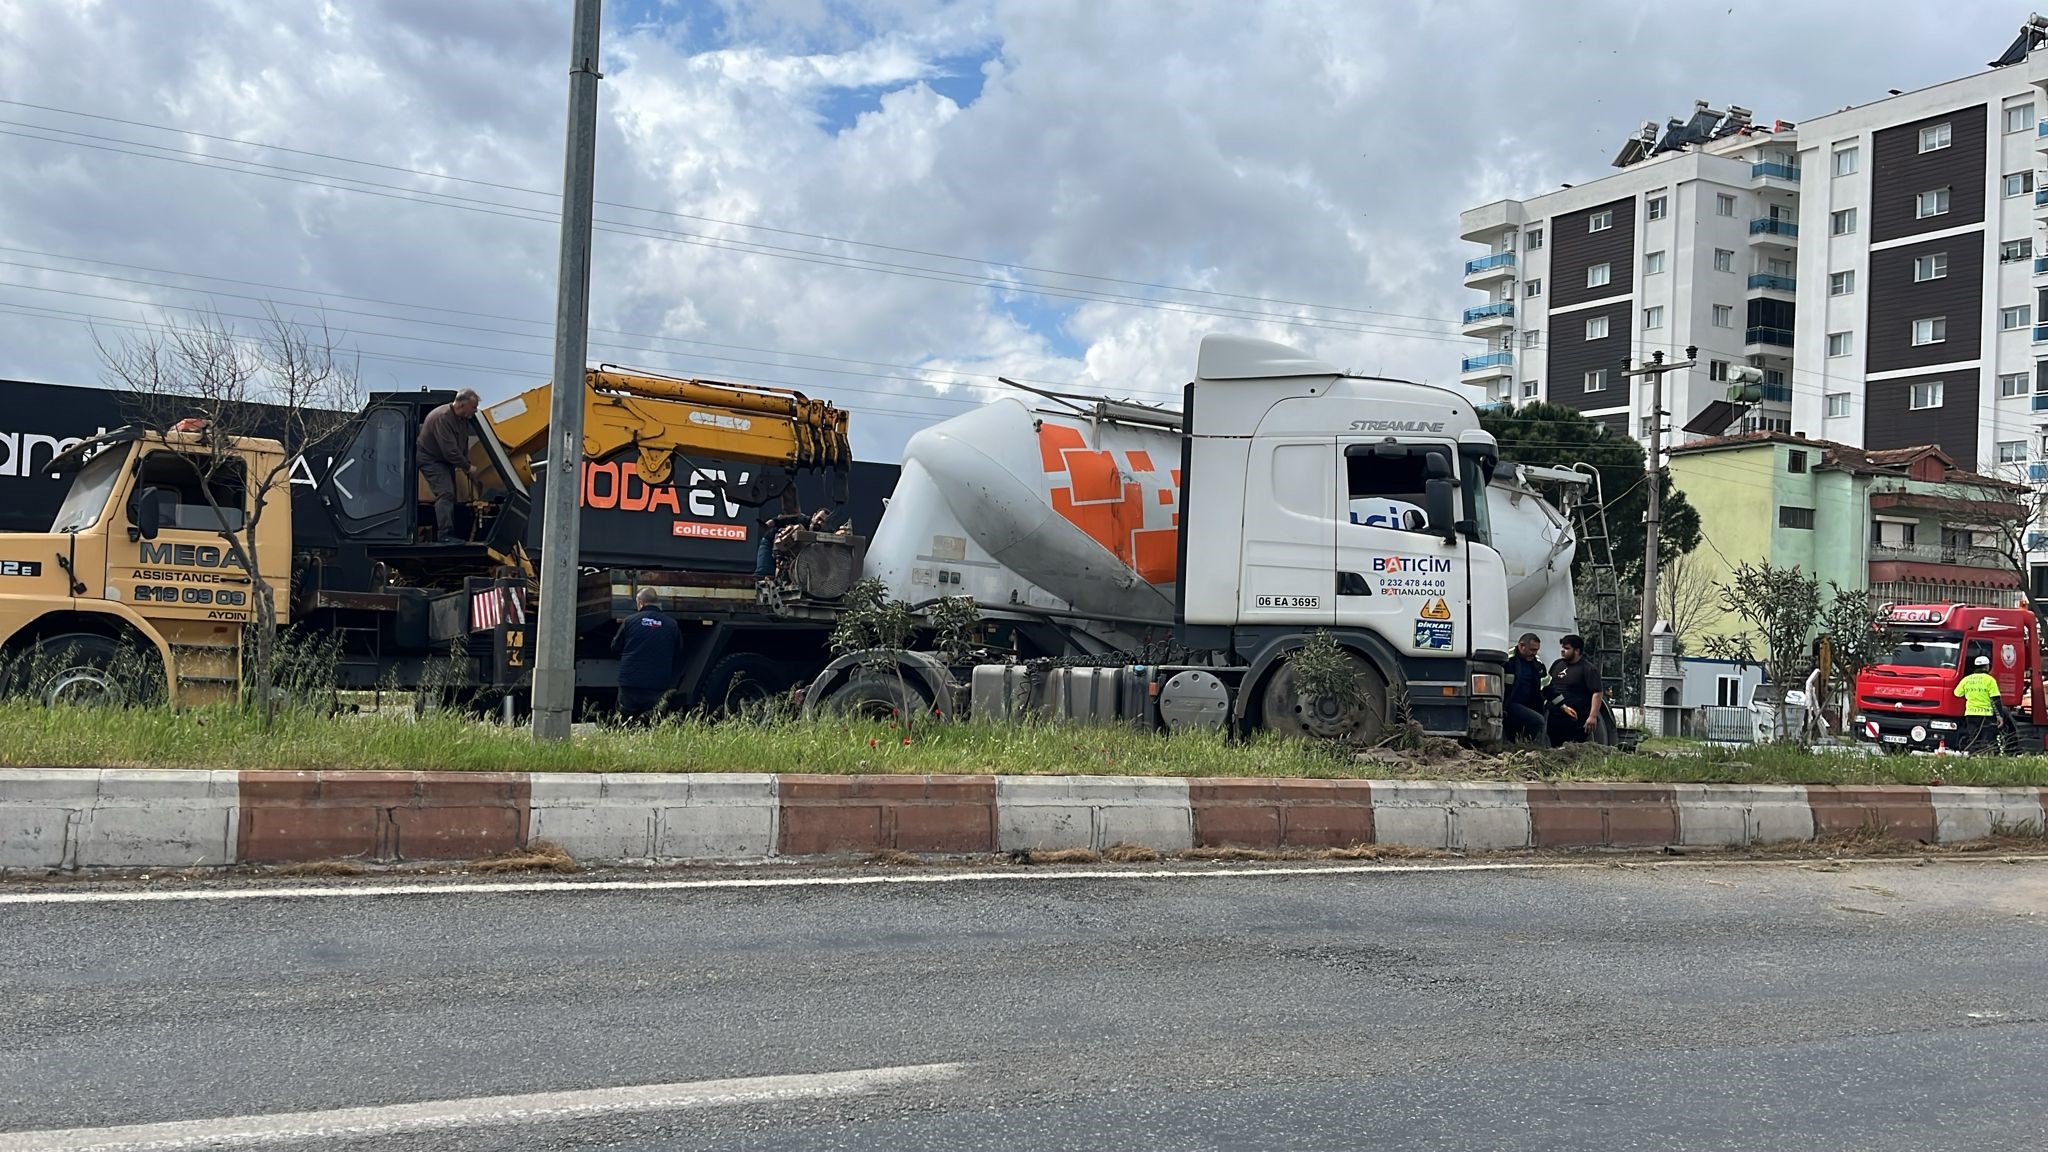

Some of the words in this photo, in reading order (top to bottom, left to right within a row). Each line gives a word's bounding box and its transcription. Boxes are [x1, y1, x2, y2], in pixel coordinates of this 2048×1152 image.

[1349, 420, 1445, 433] STREAMLINE
[580, 461, 680, 514] ODA
[675, 525, 746, 539] collection
[140, 541, 247, 570] MEGA
[1373, 555, 1452, 576] BATIÇİM
[132, 569, 220, 584] ASSISTANCE
[1379, 579, 1386, 587] 0
[1387, 579, 1403, 587] 232
[1404, 579, 1420, 587] 478
[1434, 580, 1445, 588] 00
[134, 585, 179, 602] 219
[182, 588, 213, 604] 09
[1381, 588, 1446, 597] BATIANADOLU
[1258, 596, 1271, 606] 06
[1274, 597, 1289, 606] EA
[1291, 597, 1318, 607] 3695
[207, 610, 247, 621] AYDIN
